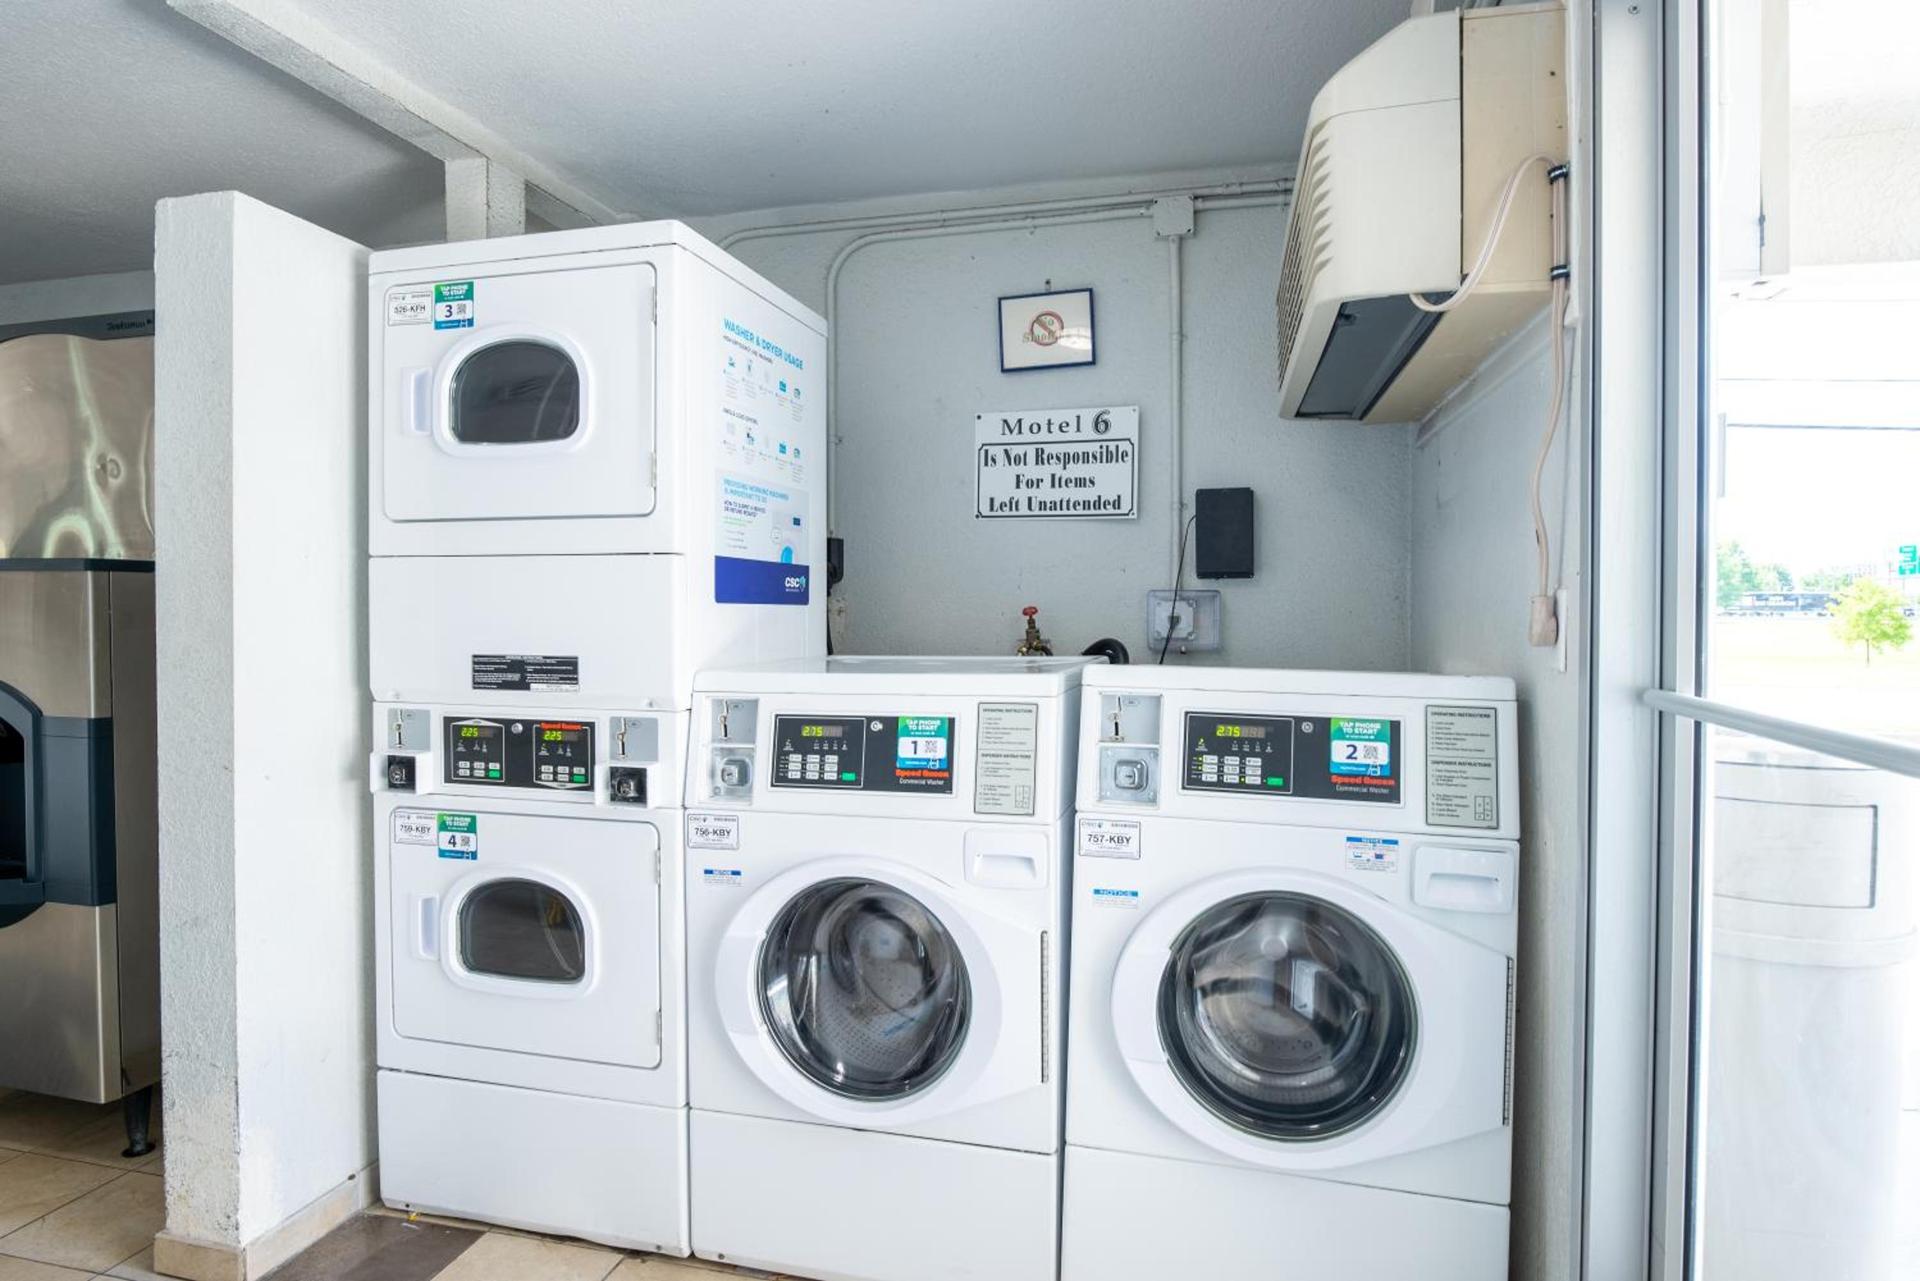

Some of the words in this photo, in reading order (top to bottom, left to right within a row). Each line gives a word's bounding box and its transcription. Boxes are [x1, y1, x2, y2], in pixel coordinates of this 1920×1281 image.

[444, 304, 453, 318] 3
[723, 318, 755, 343] WASHER
[761, 339, 783, 358] DRYER
[783, 352, 804, 371] USAGE
[1000, 414, 1082, 436] Motel
[1092, 409, 1112, 435] 6
[983, 448, 997, 467] Is
[1003, 448, 1028, 467] Not
[1034, 444, 1129, 470] Responsible
[1015, 474, 1044, 489] For
[1050, 473, 1096, 489] Items
[989, 496, 1020, 512] Left
[1027, 494, 1122, 512] Unattended
[785, 577, 800, 587] CSC
[911, 741, 918, 755] 1
[1345, 744, 1358, 760] 2
[895, 769, 921, 777] Speed
[922, 769, 949, 778] Queen
[1331, 775, 1362, 784] Speed
[1363, 776, 1395, 785] Queen
[448, 834, 457, 848] 4
[1087, 833, 1132, 845] 757-KBY
